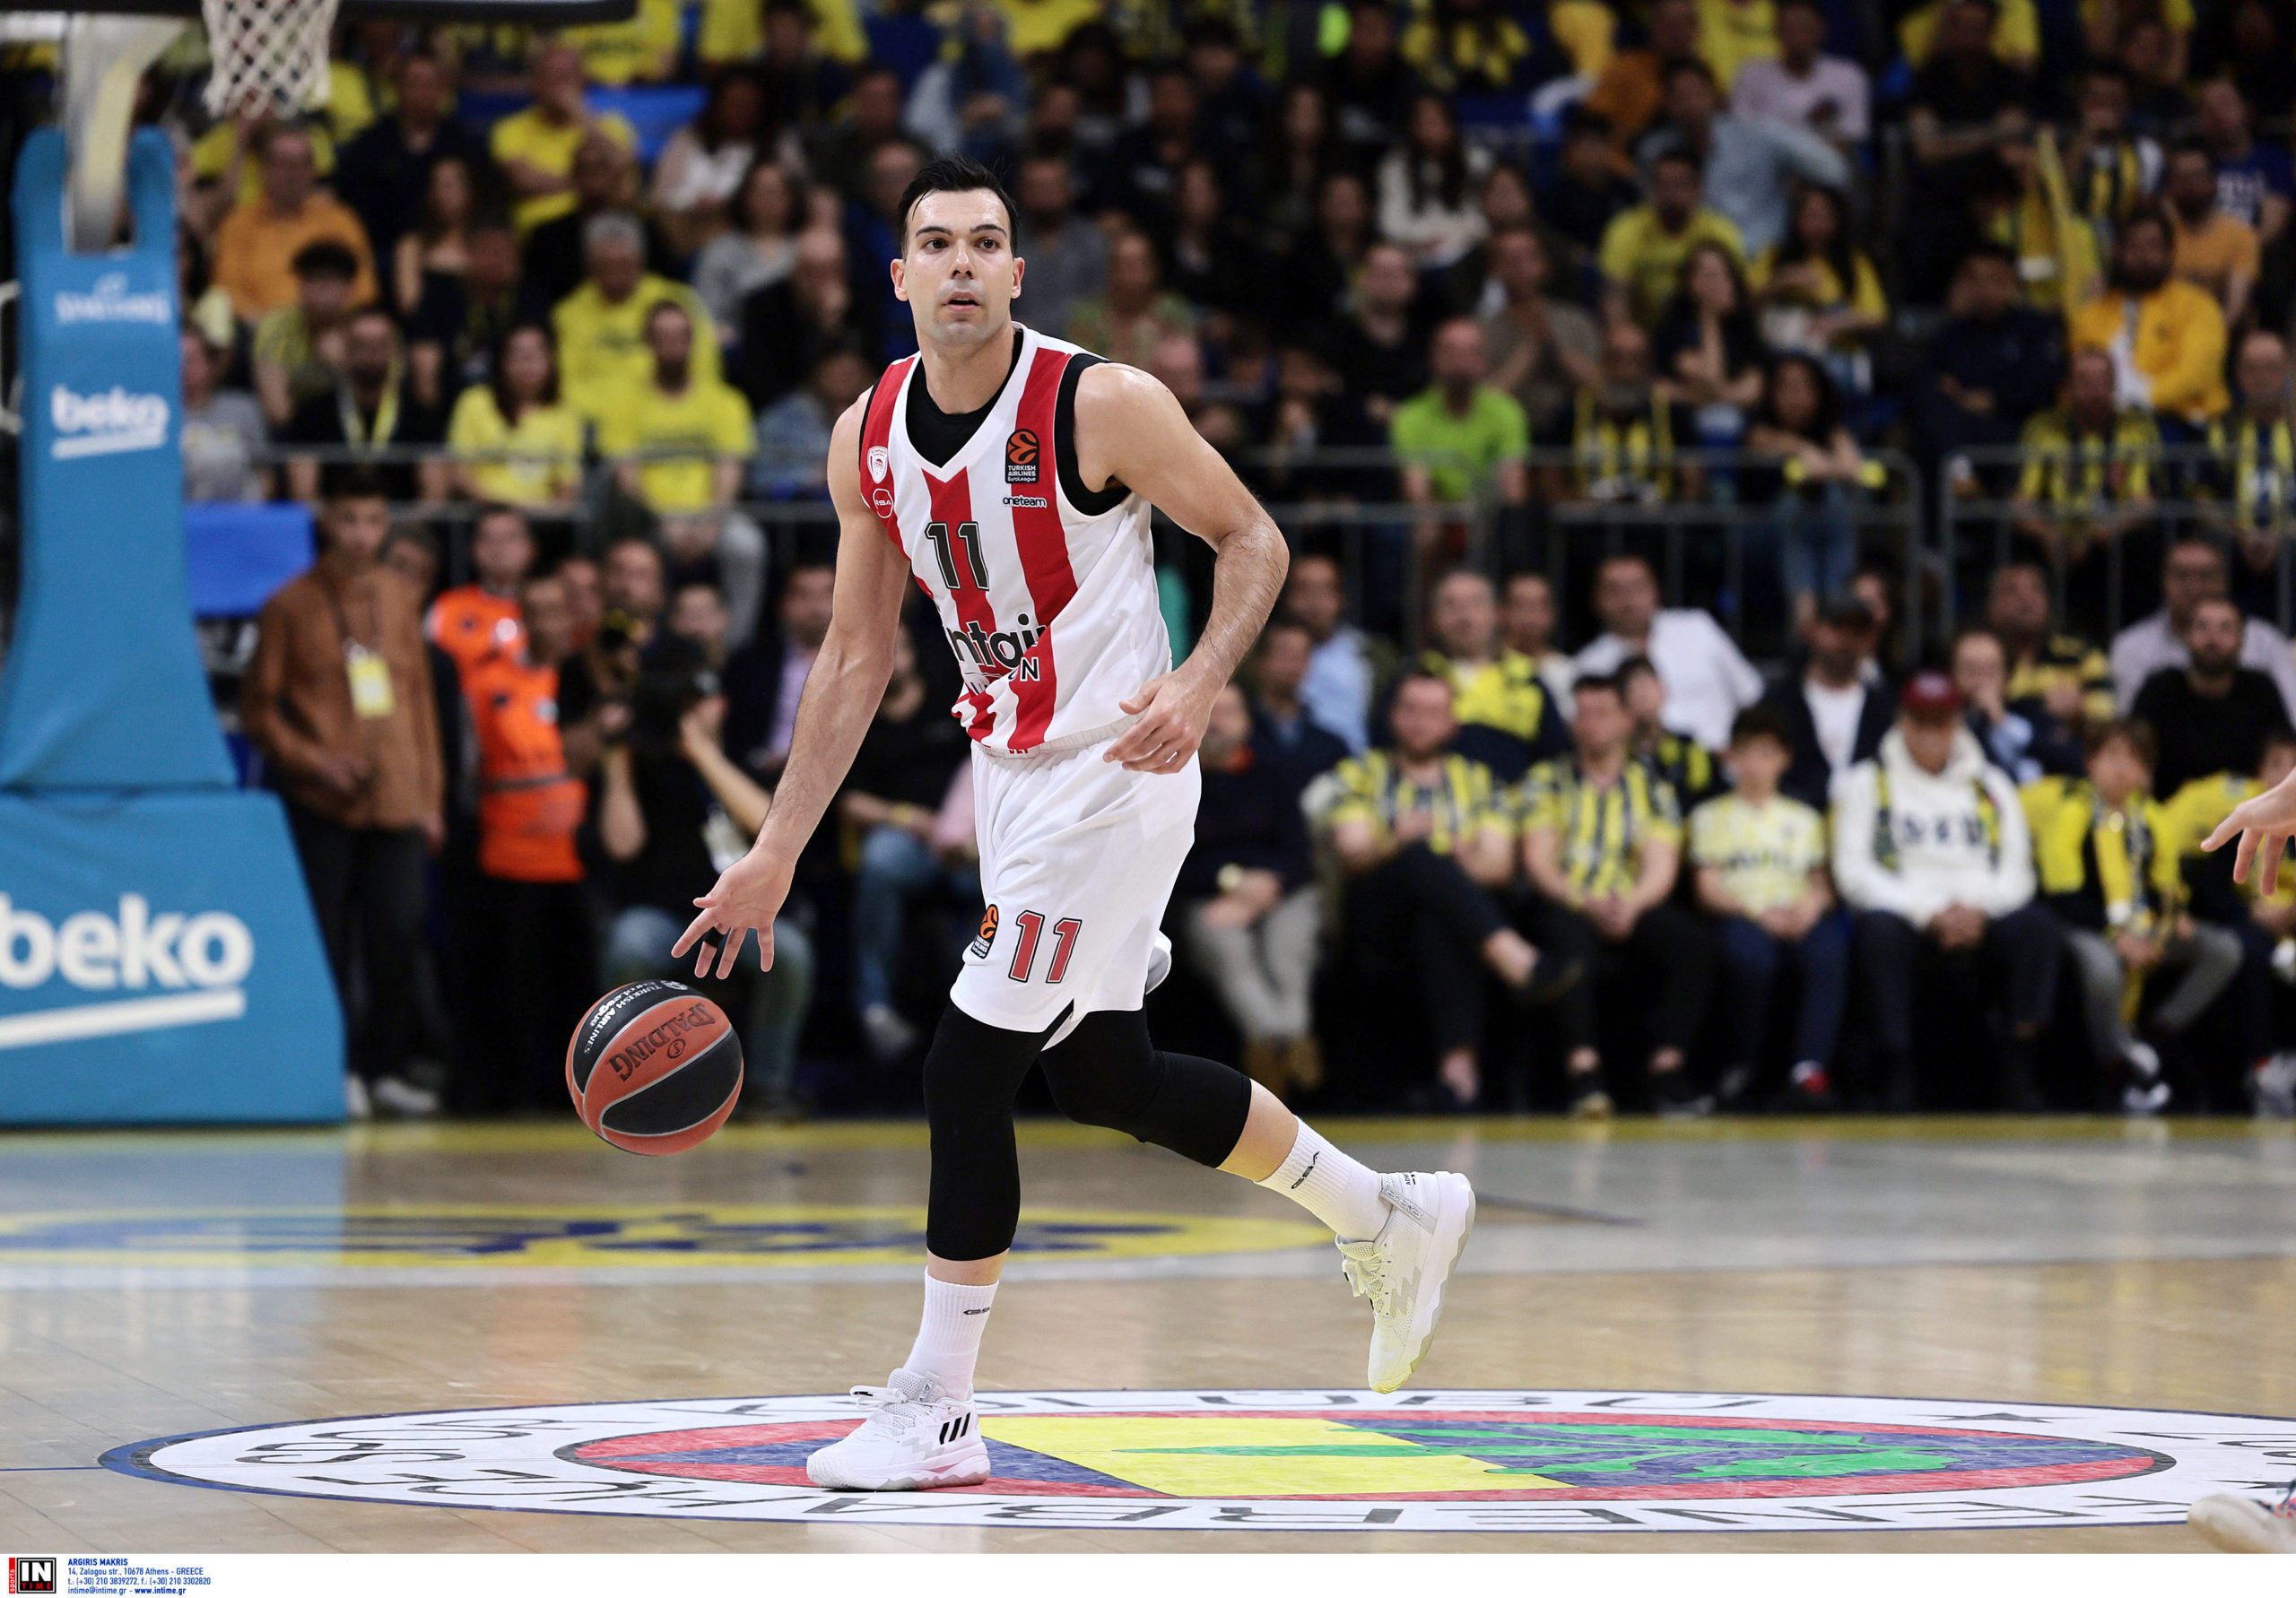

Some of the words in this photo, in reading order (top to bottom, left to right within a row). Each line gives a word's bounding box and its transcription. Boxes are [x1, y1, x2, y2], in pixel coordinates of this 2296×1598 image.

[51, 385, 170, 432] beko
[1003, 495, 1048, 508] oneteam
[925, 521, 990, 591] 11
[0, 891, 255, 990] beko
[1008, 909, 1083, 984] 11
[584, 1008, 616, 1054] AIRLINES
[607, 1003, 716, 1082] SPALDING
